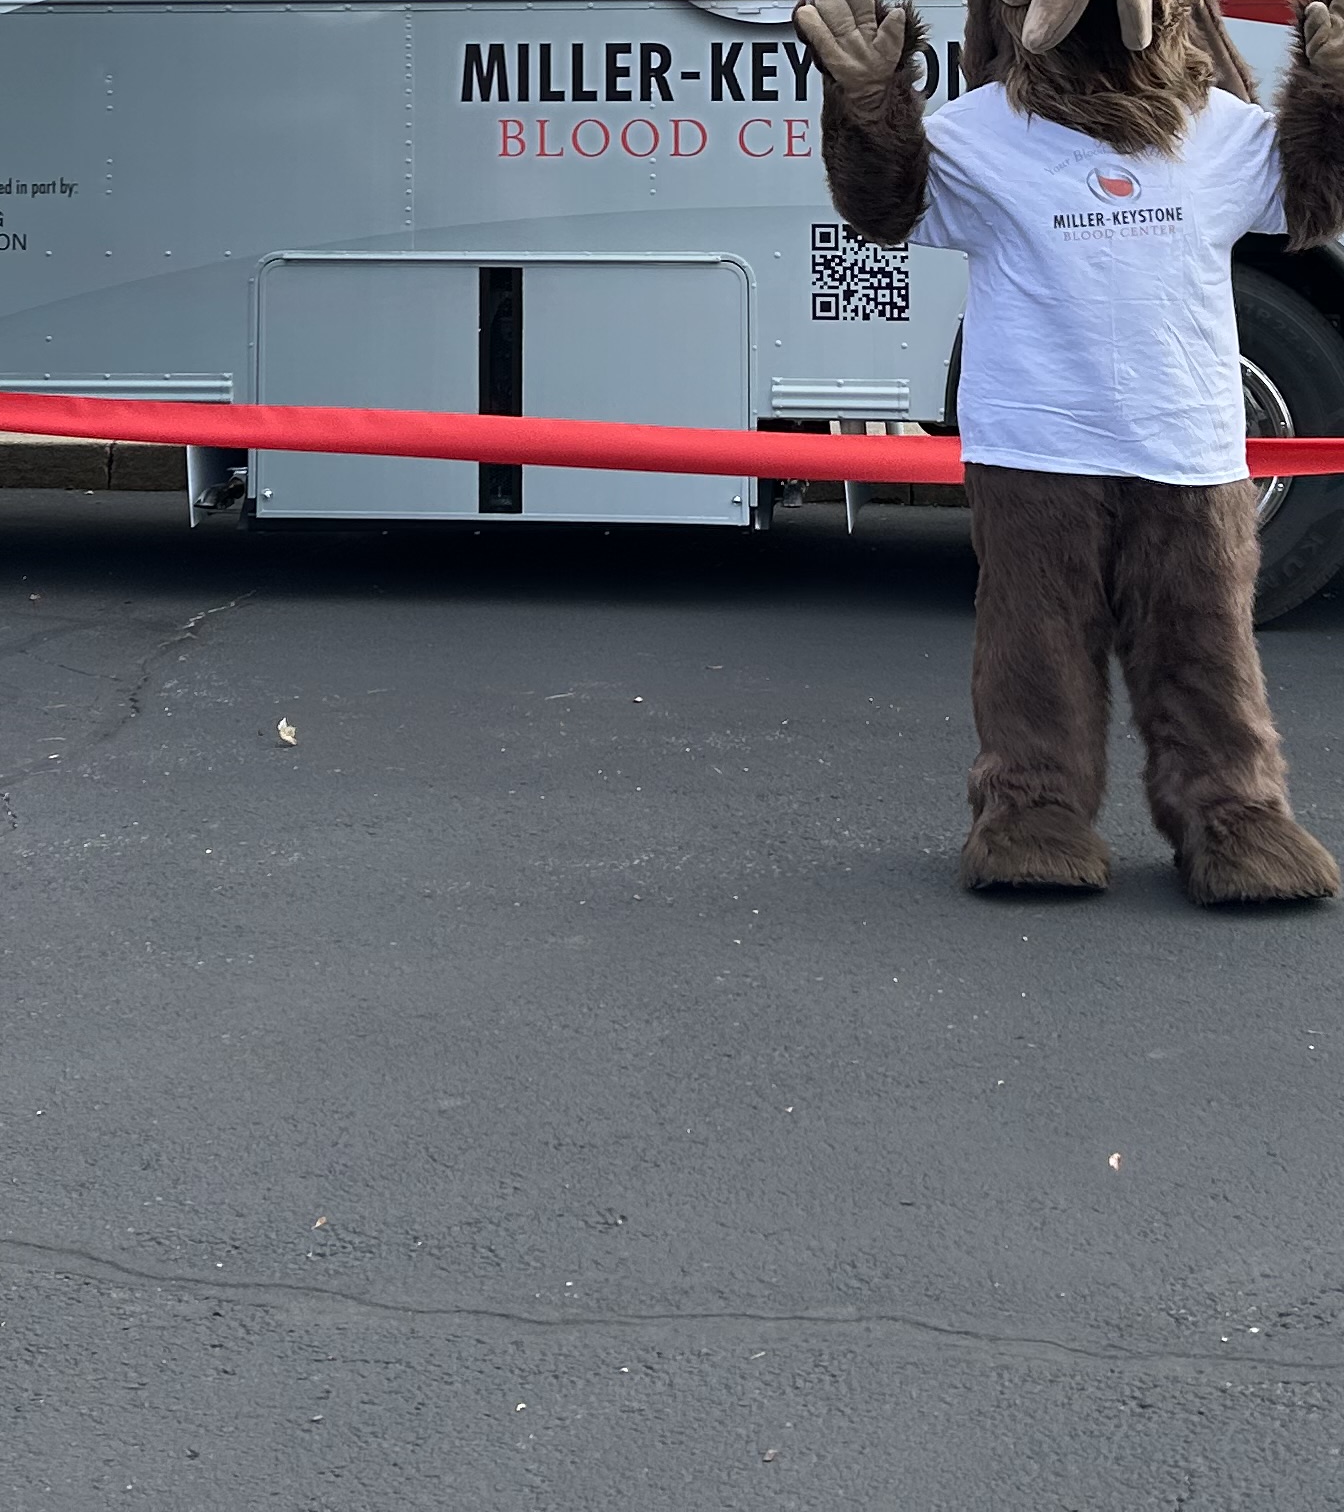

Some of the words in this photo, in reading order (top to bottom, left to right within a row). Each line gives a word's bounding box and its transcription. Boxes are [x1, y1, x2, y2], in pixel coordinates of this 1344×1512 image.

[498, 119, 708, 158] BLOOD
[16, 180, 28, 195] in
[31, 180, 56, 198] part
[59, 177, 79, 198] by:
[1053, 206, 1184, 230] MILLER-KEYSTONE
[1063, 228, 1116, 242] BLOOD
[1119, 224, 1177, 239] CENTER
